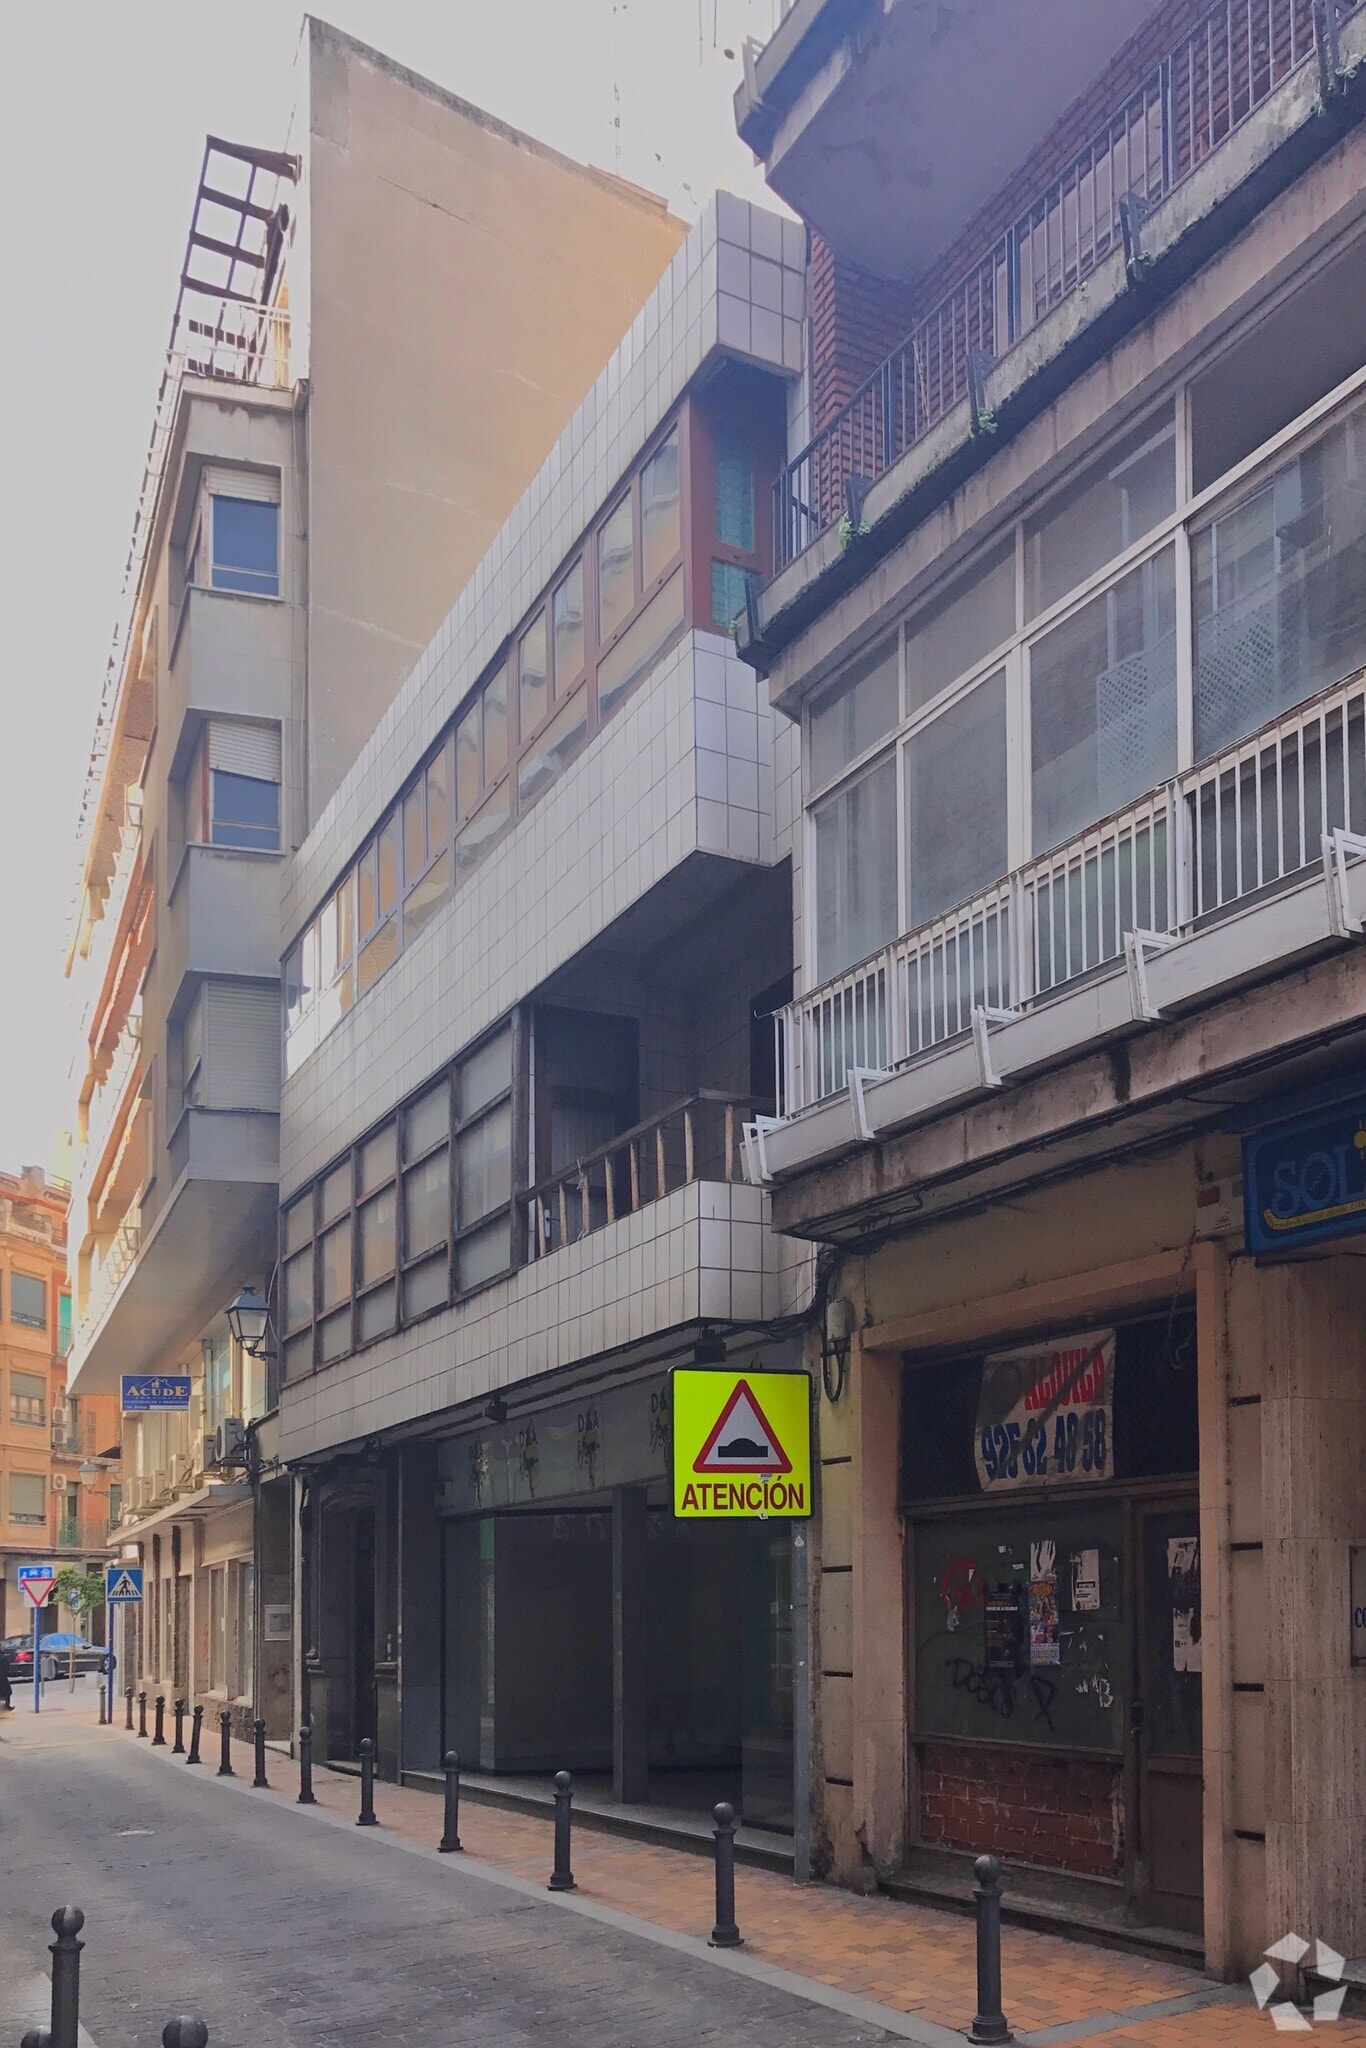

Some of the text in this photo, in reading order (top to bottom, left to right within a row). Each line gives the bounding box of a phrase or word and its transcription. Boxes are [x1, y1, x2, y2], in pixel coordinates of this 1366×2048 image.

[126, 1385, 188, 1397] ACUDE
[981, 1422, 1021, 1480] 925
[1081, 1407, 1107, 1472] 58
[681, 1475, 804, 1510] ATENCIÓN
